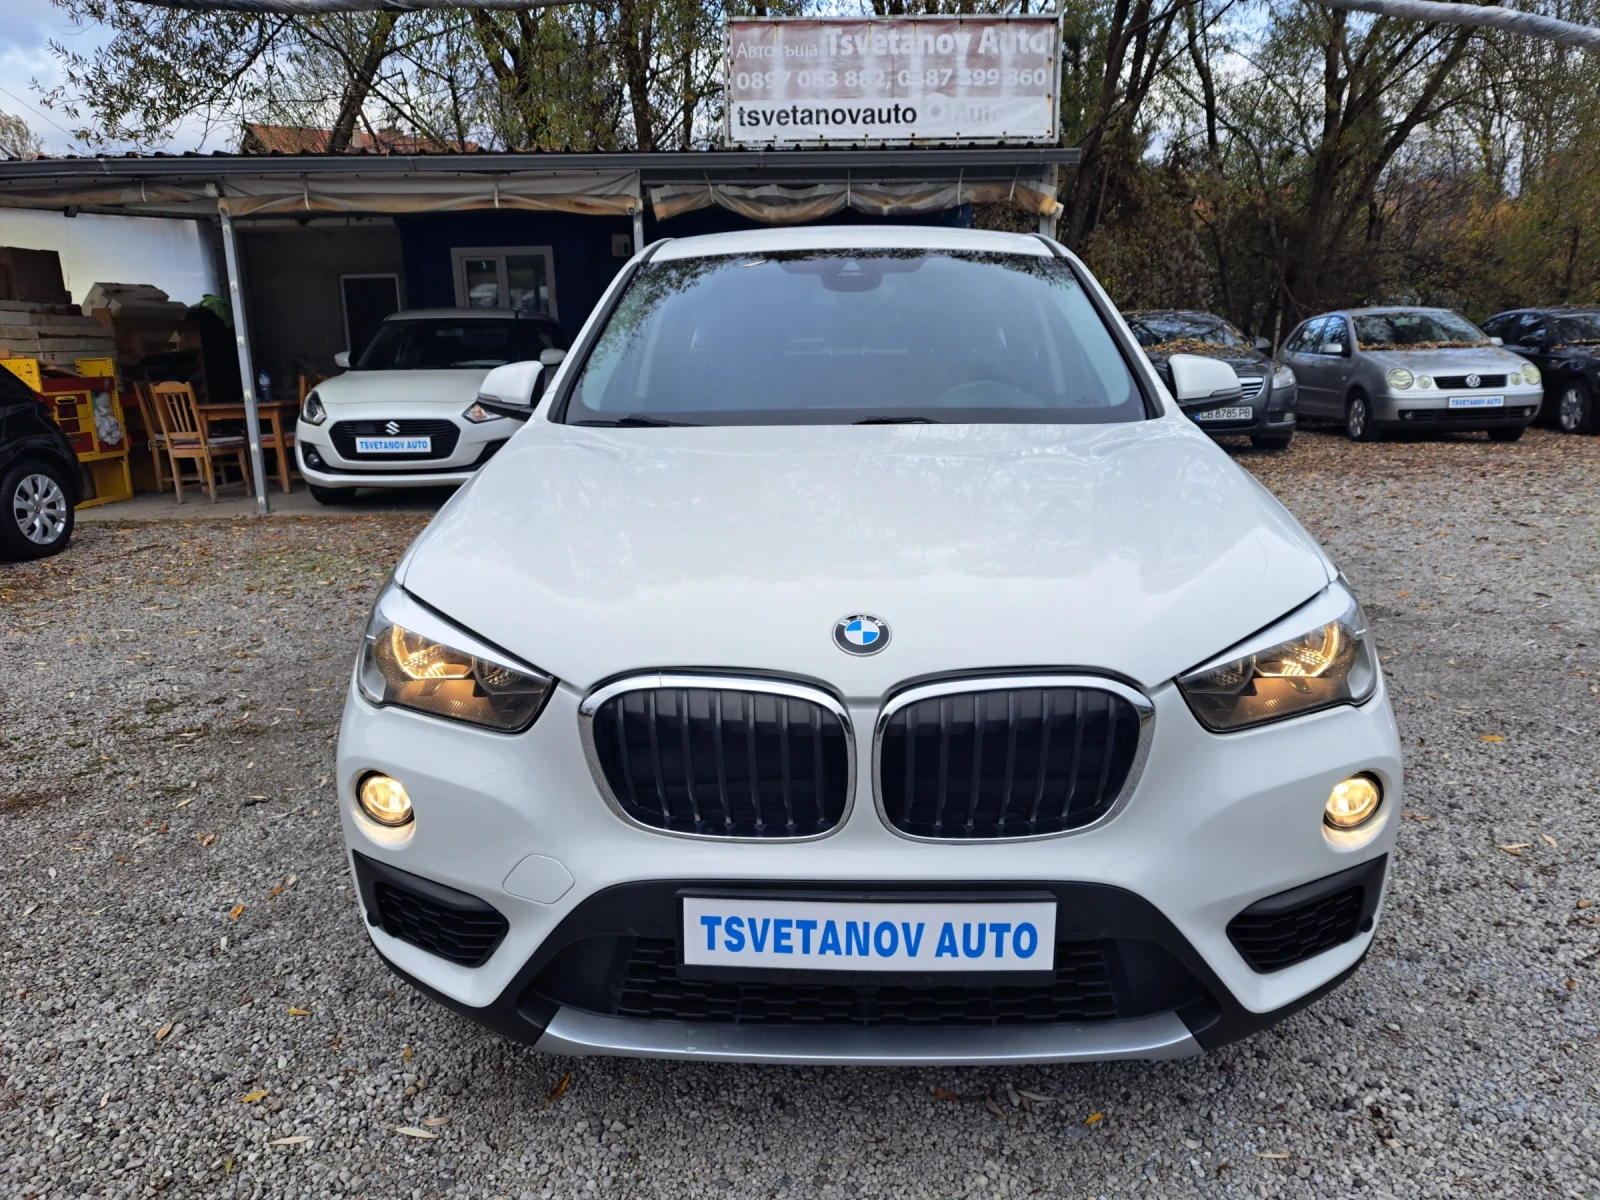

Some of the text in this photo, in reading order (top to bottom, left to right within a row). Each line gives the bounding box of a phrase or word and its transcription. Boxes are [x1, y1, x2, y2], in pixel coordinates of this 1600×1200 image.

[824, 26, 1047, 56] Tsvetanov Auto
[738, 103, 917, 127] tsvetanovauto
[1451, 398, 1485, 406] TSVETANOV
[1215, 409, 1237, 418] 8785
[360, 441, 428, 449] TSVETANOV AUTO
[700, 915, 1039, 959] TSVETANOV AUTO
